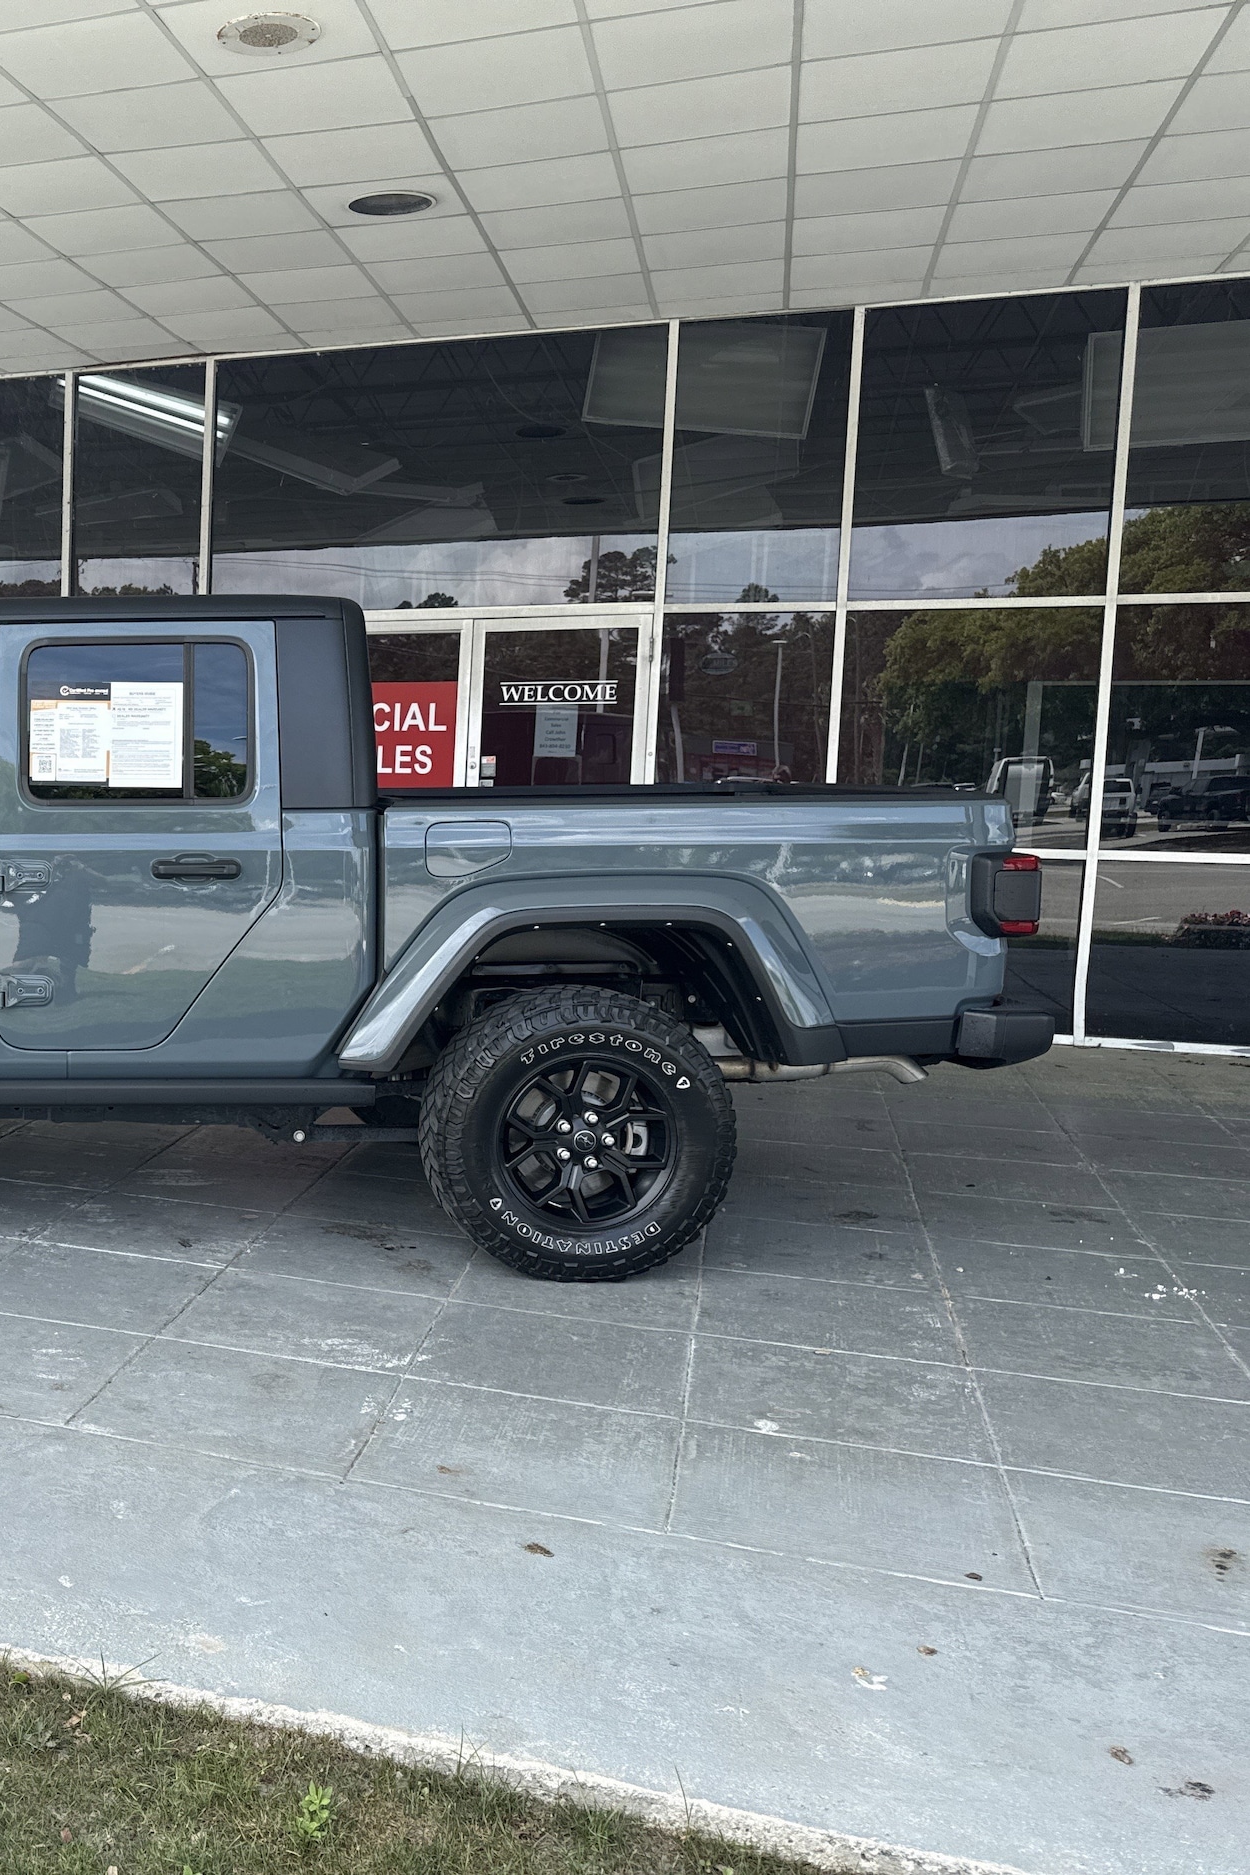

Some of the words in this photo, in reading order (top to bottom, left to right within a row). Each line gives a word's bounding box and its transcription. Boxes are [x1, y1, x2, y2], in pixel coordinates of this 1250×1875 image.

[501, 684, 617, 701] WELCOME
[373, 702, 447, 732] CIAL
[377, 745, 433, 774] LES
[520, 1032, 678, 1076] Firestone
[502, 1210, 662, 1255] DESTINATION
